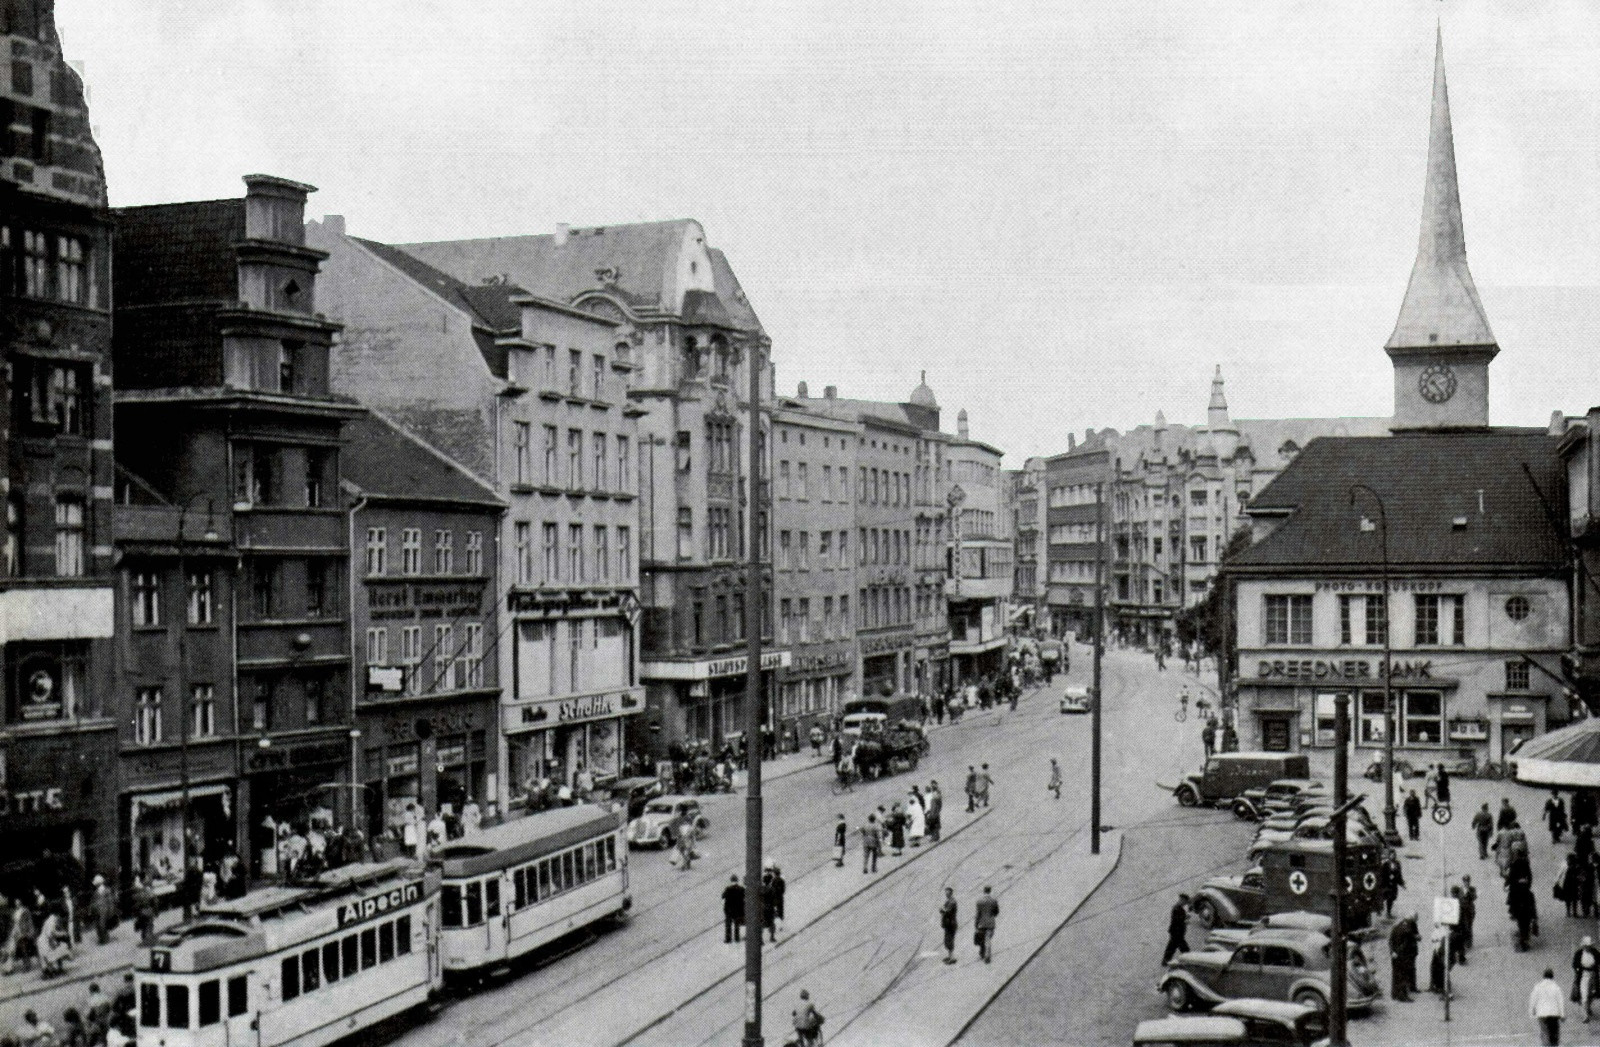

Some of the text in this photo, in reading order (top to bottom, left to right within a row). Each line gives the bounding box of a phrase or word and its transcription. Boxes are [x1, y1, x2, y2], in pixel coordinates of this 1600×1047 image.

[1258, 660, 1370, 678] DRESDNER
[343, 885, 418, 922] Alpecin
[154, 953, 165, 968] 7
